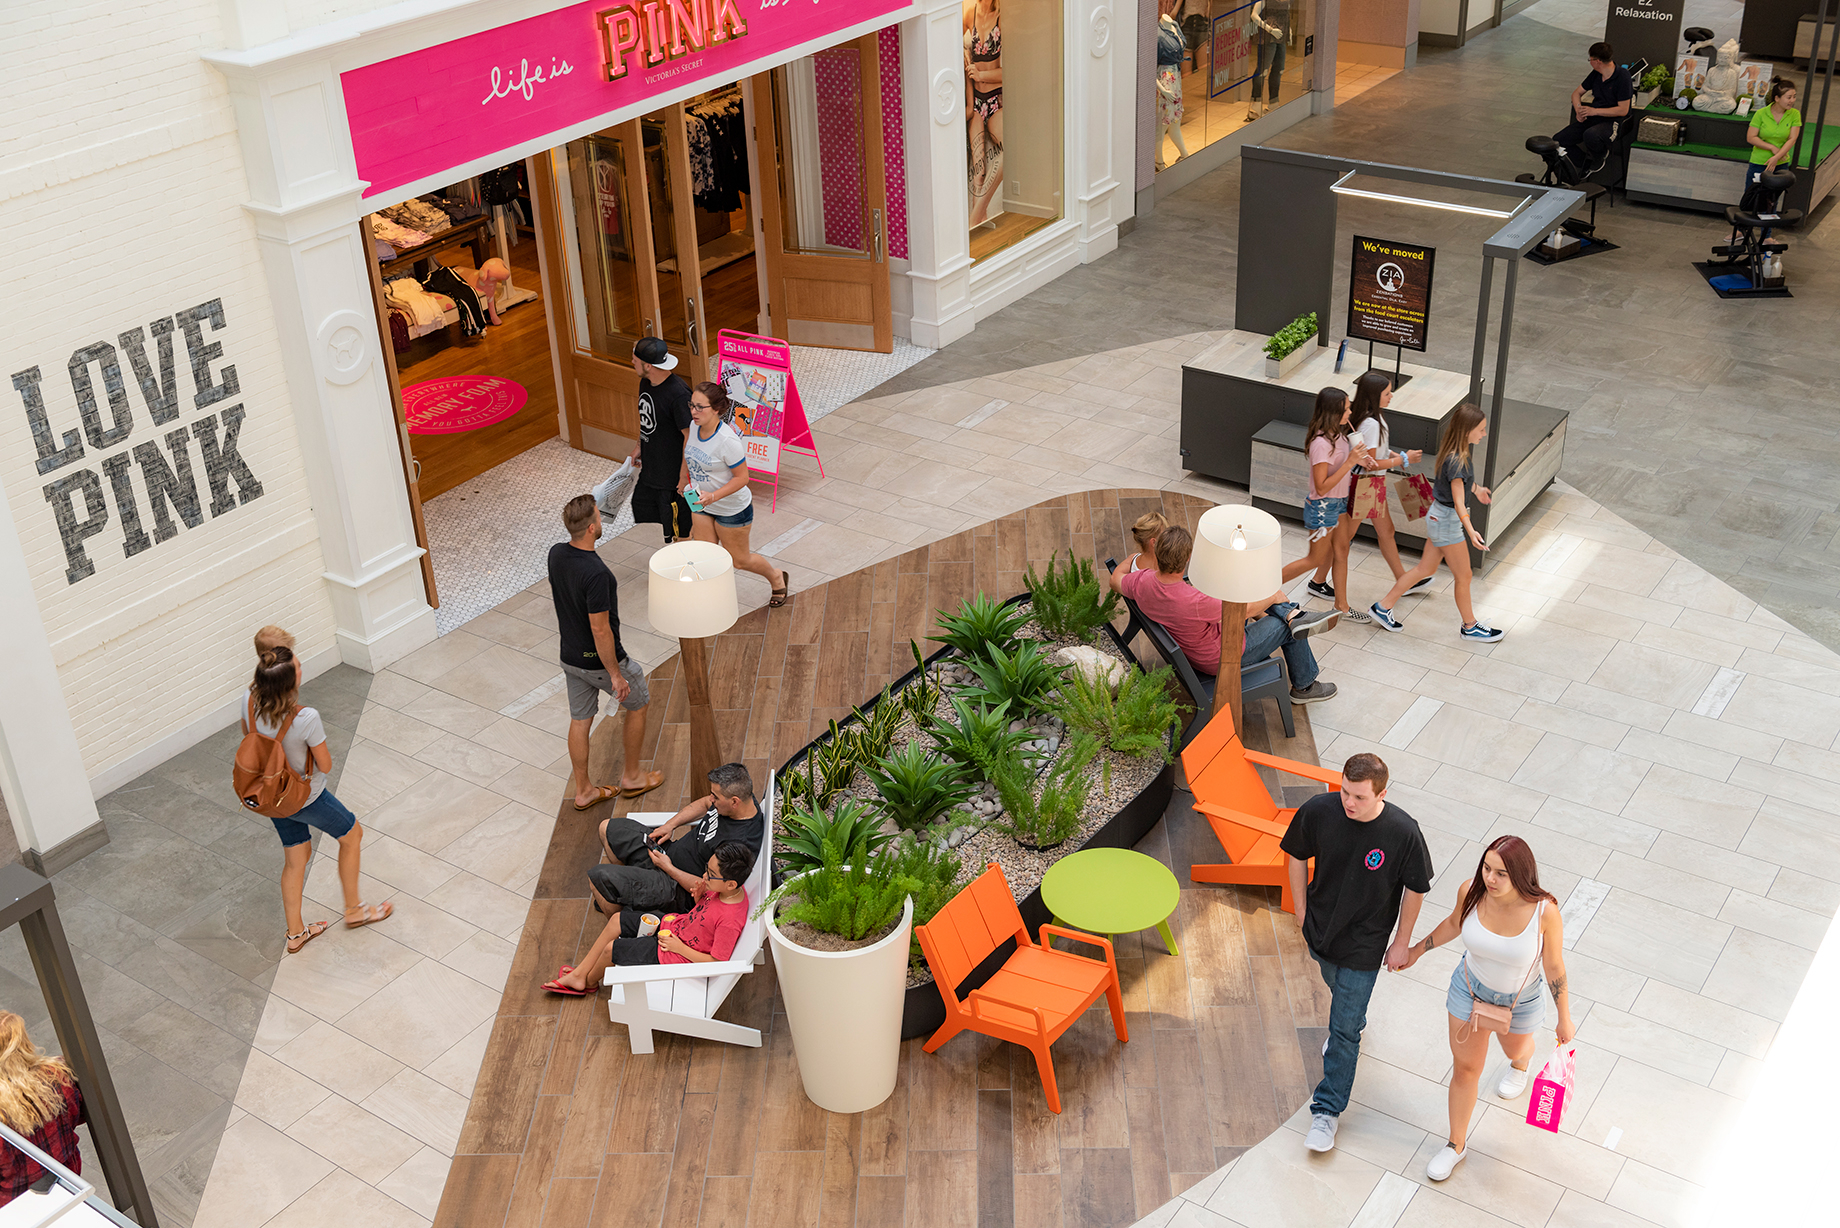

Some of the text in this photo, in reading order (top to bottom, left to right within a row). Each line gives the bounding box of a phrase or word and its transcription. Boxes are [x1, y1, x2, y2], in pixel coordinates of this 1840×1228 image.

[1615, 6, 1673, 21] Relaxation
[597, 0, 748, 82] PINK
[1215, 27, 1241, 52] REDEEM
[1215, 40, 1252, 70] HAUTE CASH
[482, 56, 575, 105] life is
[645, 58, 704, 85] VICTORIA'S SECRET
[1214, 67, 1230, 88] NOW
[1362, 241, 1424, 260] We've moved
[1382, 269, 1401, 279] ZIA
[1399, 315, 1424, 323] escalators
[738, 345, 748, 354] ALL
[750, 347, 764, 356] PINK
[10, 297, 241, 476] LOVE
[458, 379, 506, 400] FOAM
[747, 441, 768, 457] FREE
[42, 402, 265, 585] PINK
[1536, 1085, 1556, 1124] PINK
